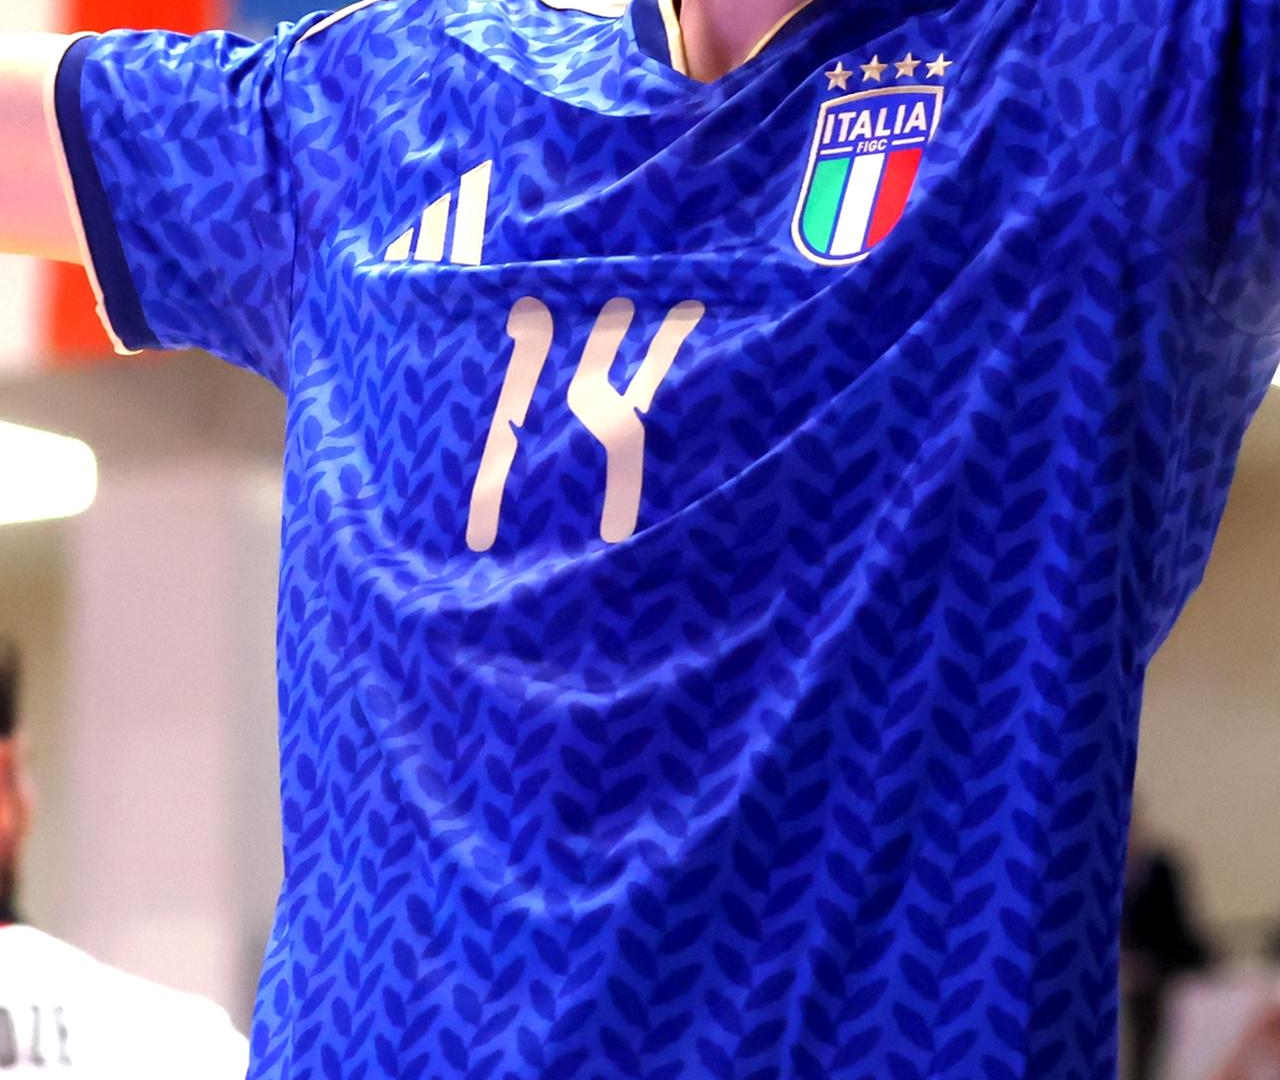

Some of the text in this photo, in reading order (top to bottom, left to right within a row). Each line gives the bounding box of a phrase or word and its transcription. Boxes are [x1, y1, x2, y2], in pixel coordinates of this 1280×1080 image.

[822, 101, 928, 144] ITALIA
[856, 138, 888, 152] FIGC
[465, 295, 706, 552] 14
